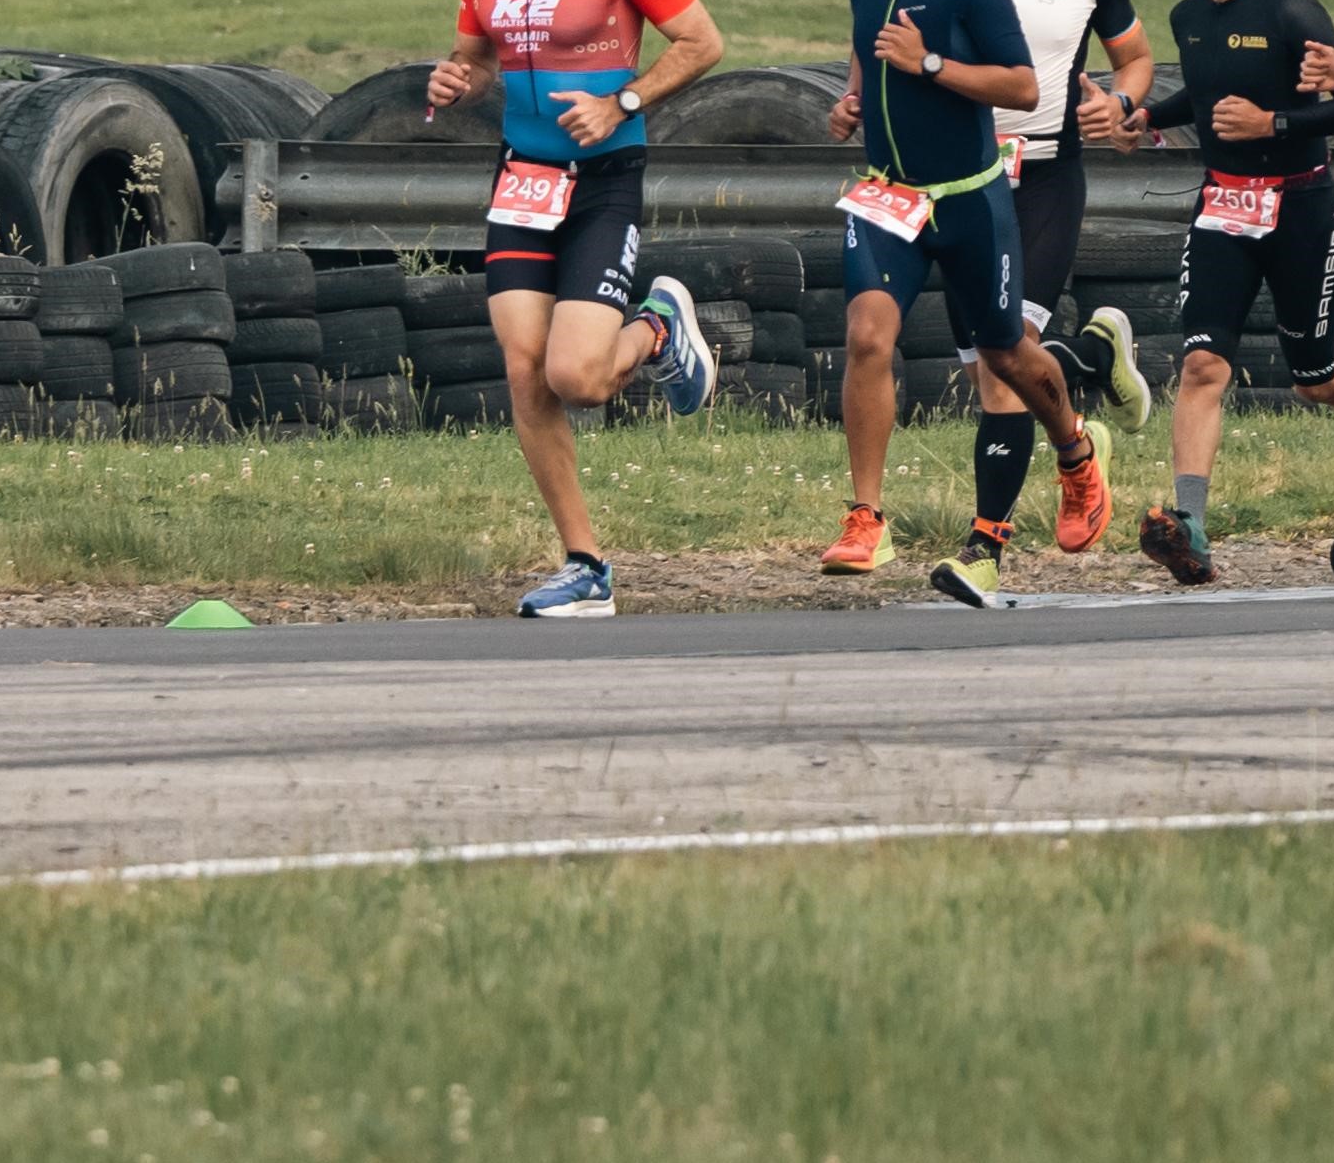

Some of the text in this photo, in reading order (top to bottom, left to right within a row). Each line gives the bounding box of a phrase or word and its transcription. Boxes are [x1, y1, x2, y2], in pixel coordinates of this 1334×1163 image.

[501, 175, 552, 202] 249
[1208, 186, 1257, 213] 250
[999, 253, 1010, 310] orca
